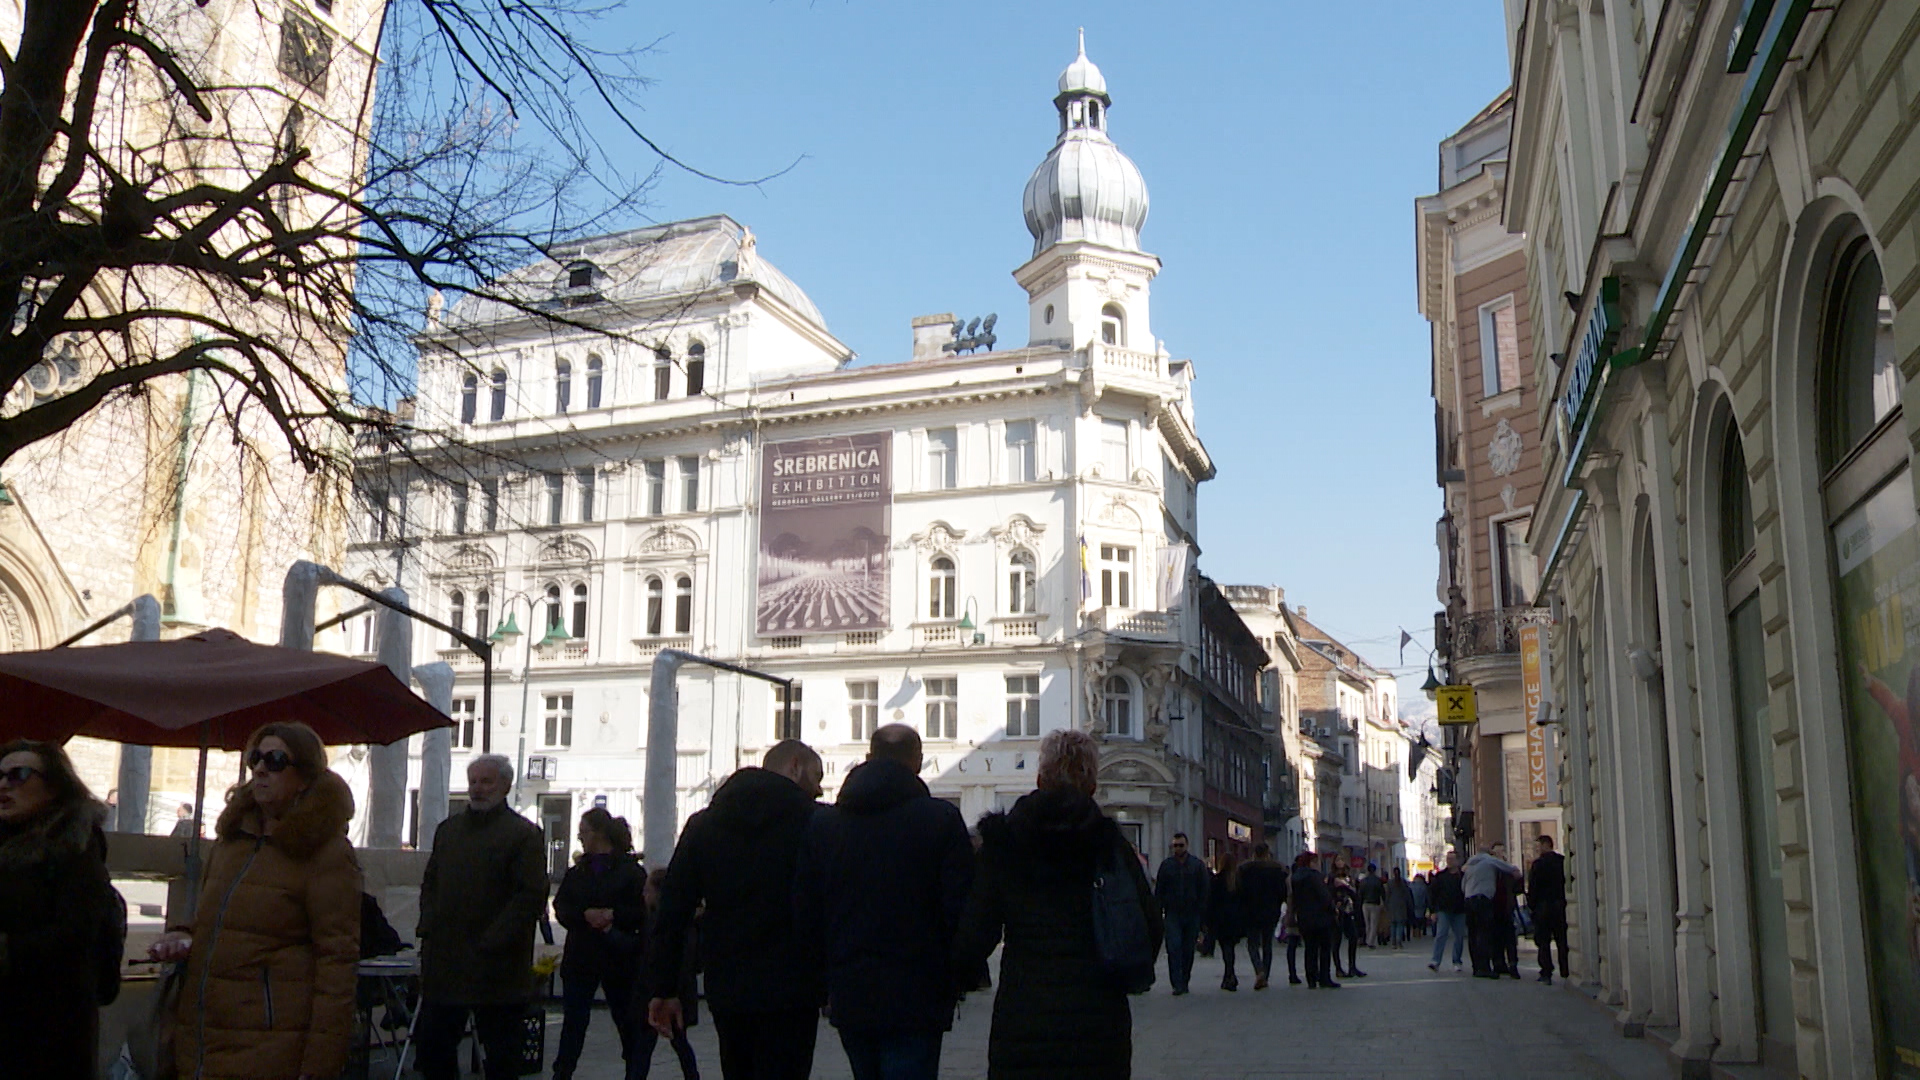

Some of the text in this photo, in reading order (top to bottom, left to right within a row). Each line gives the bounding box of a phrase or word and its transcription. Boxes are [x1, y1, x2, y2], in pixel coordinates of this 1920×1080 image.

[1565, 287, 1609, 434] SBERBANK
[772, 473, 881, 494] EXHIBITION
[773, 449, 880, 476] SREBRENICA
[1527, 682, 1545, 796] EXCHANGE
